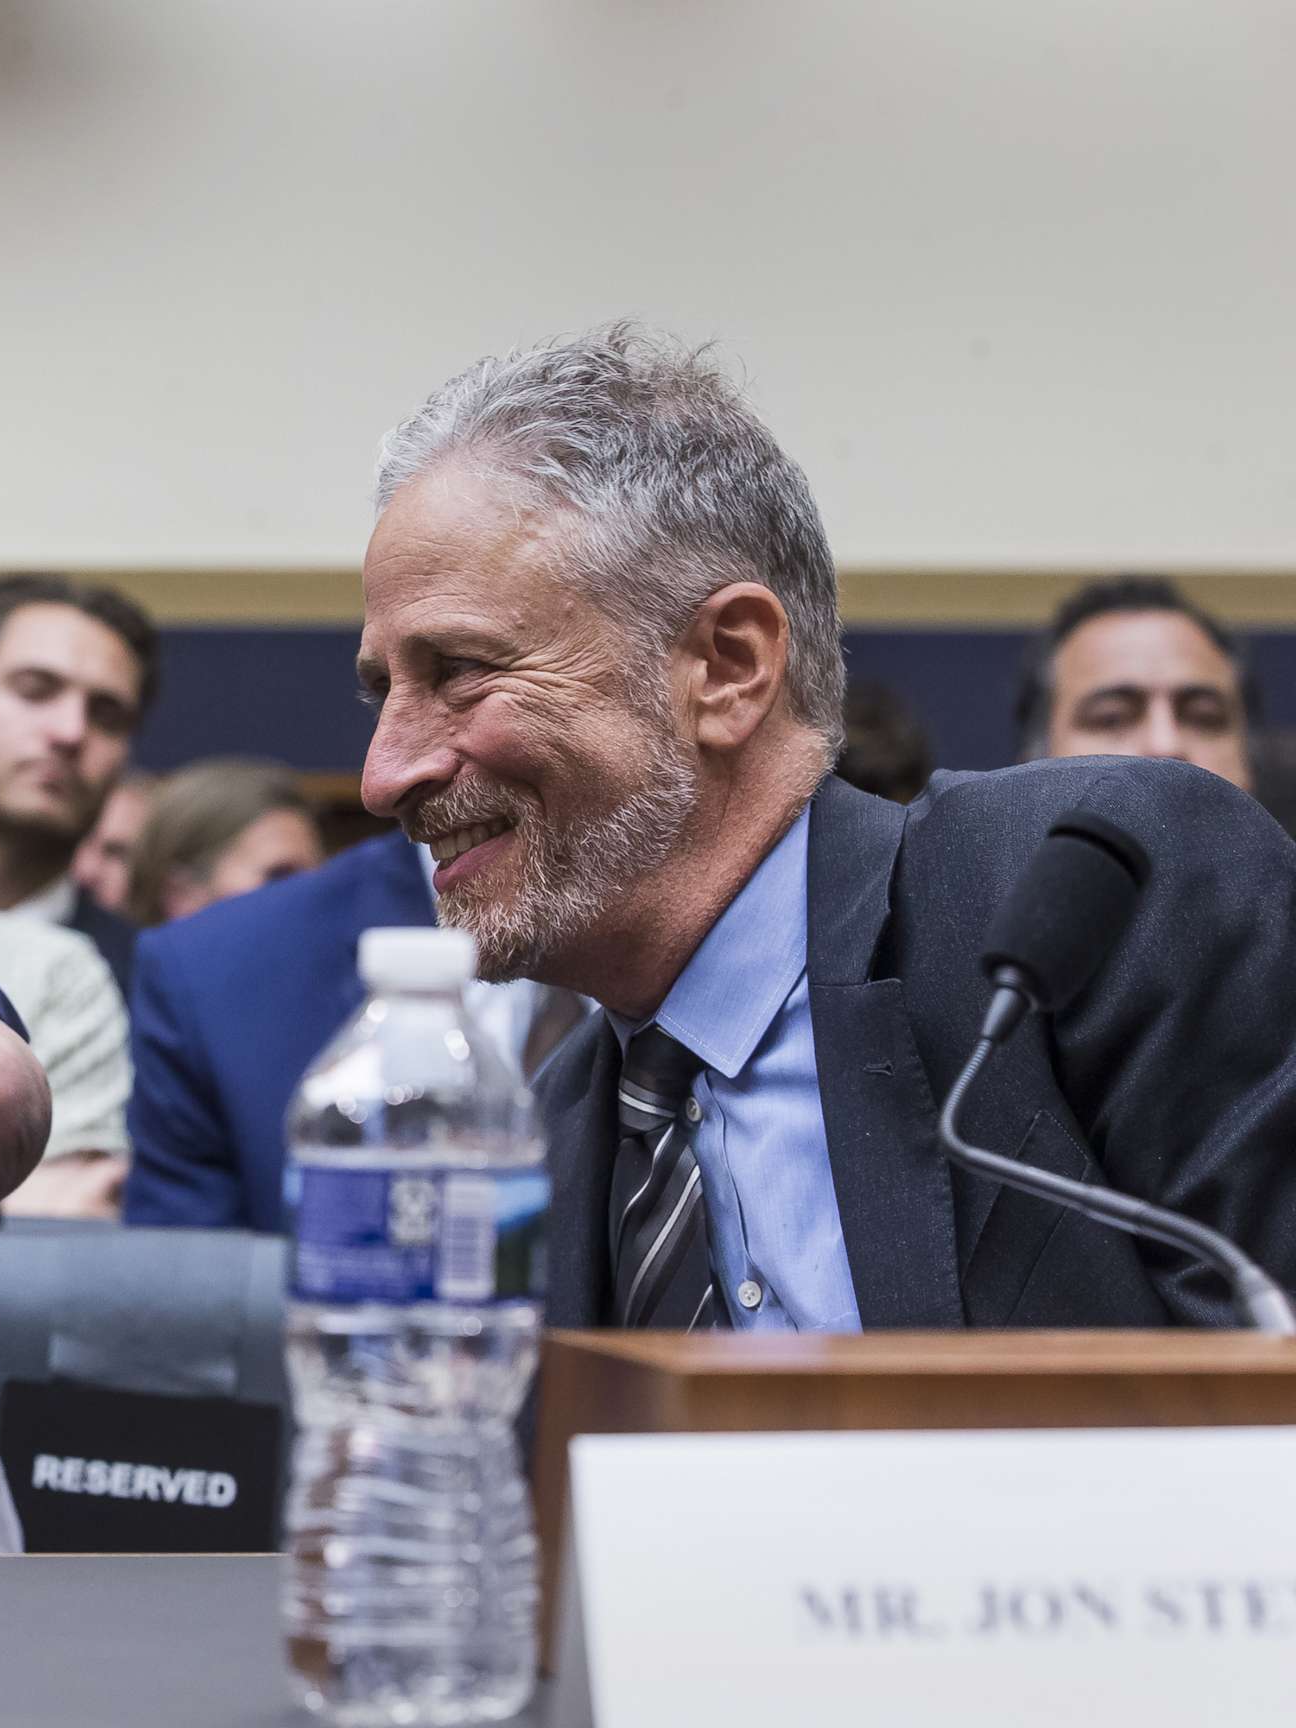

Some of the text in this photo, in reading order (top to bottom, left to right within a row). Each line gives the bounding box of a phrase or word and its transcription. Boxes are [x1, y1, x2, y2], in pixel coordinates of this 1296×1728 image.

[31, 1453, 238, 1508] RESERVED
[966, 1578, 1120, 1642] JON
[1140, 1578, 1296, 1642] STE
